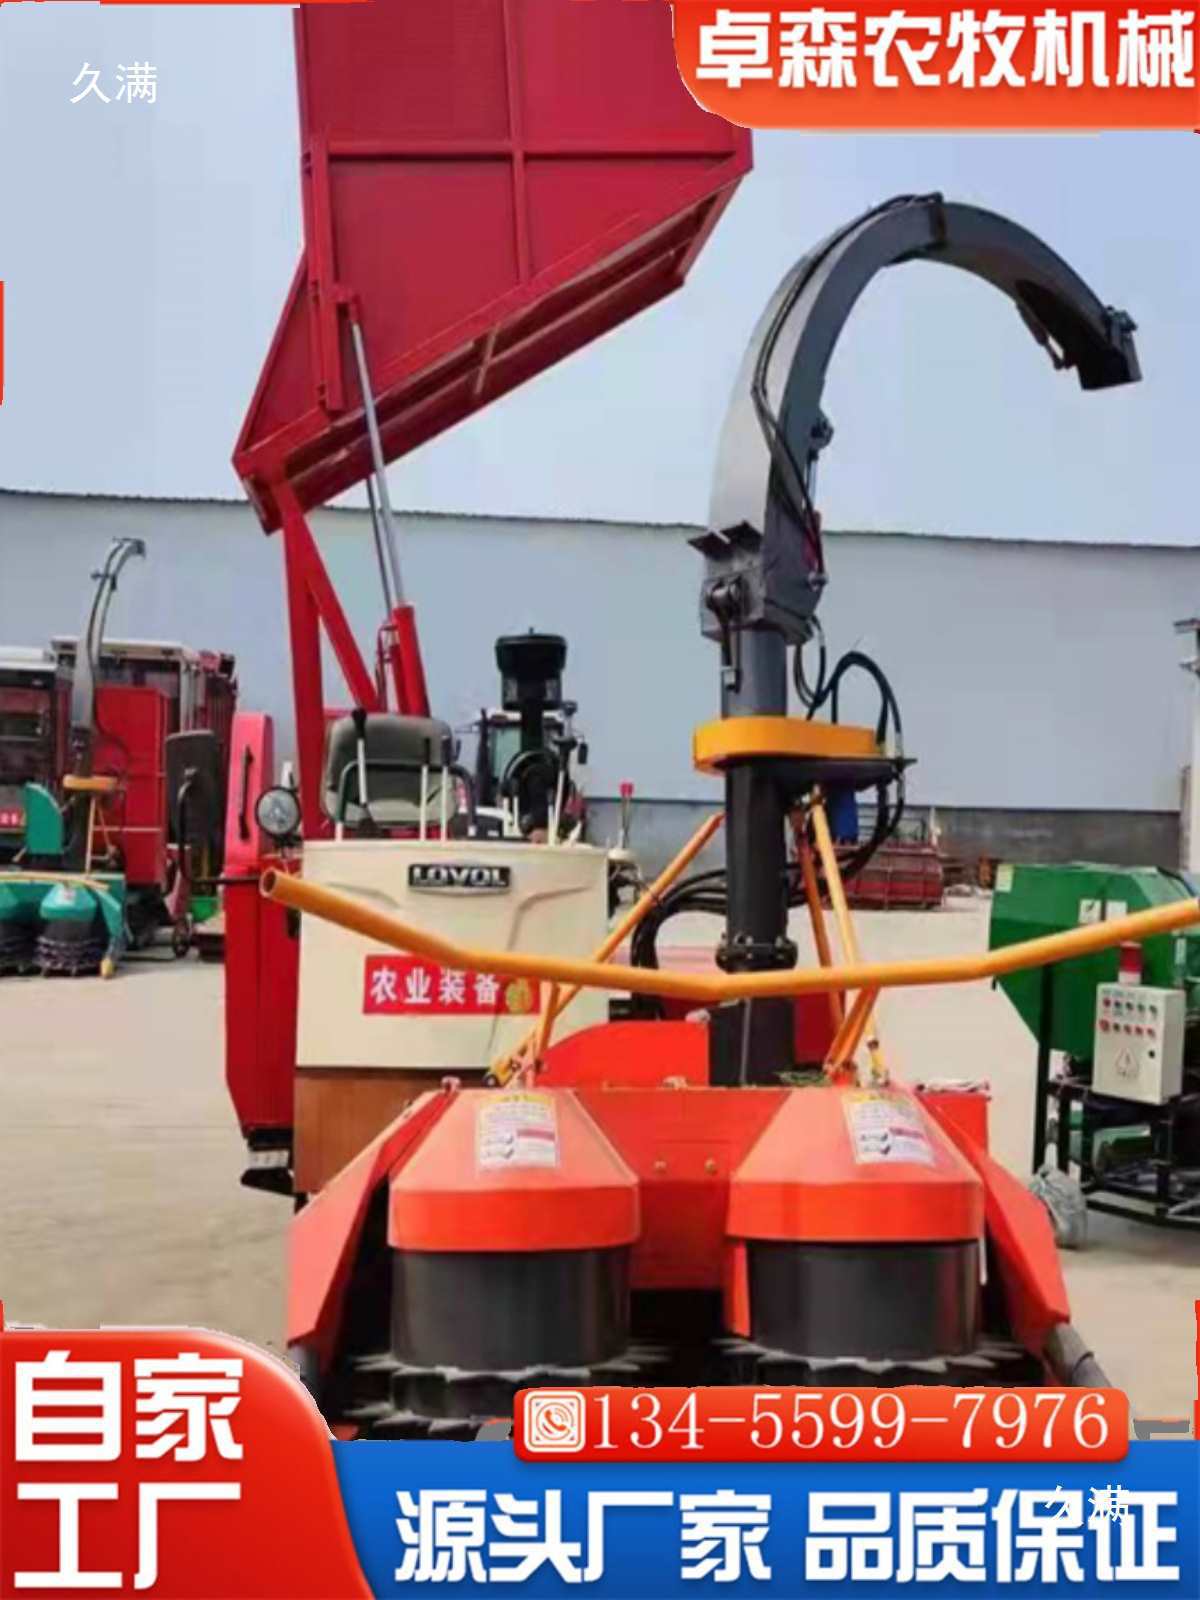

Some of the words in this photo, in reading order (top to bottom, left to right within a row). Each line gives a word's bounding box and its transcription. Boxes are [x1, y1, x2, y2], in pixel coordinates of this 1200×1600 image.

[413, 867, 507, 886] LOVOL
[370, 965, 500, 1006] 农业装备
